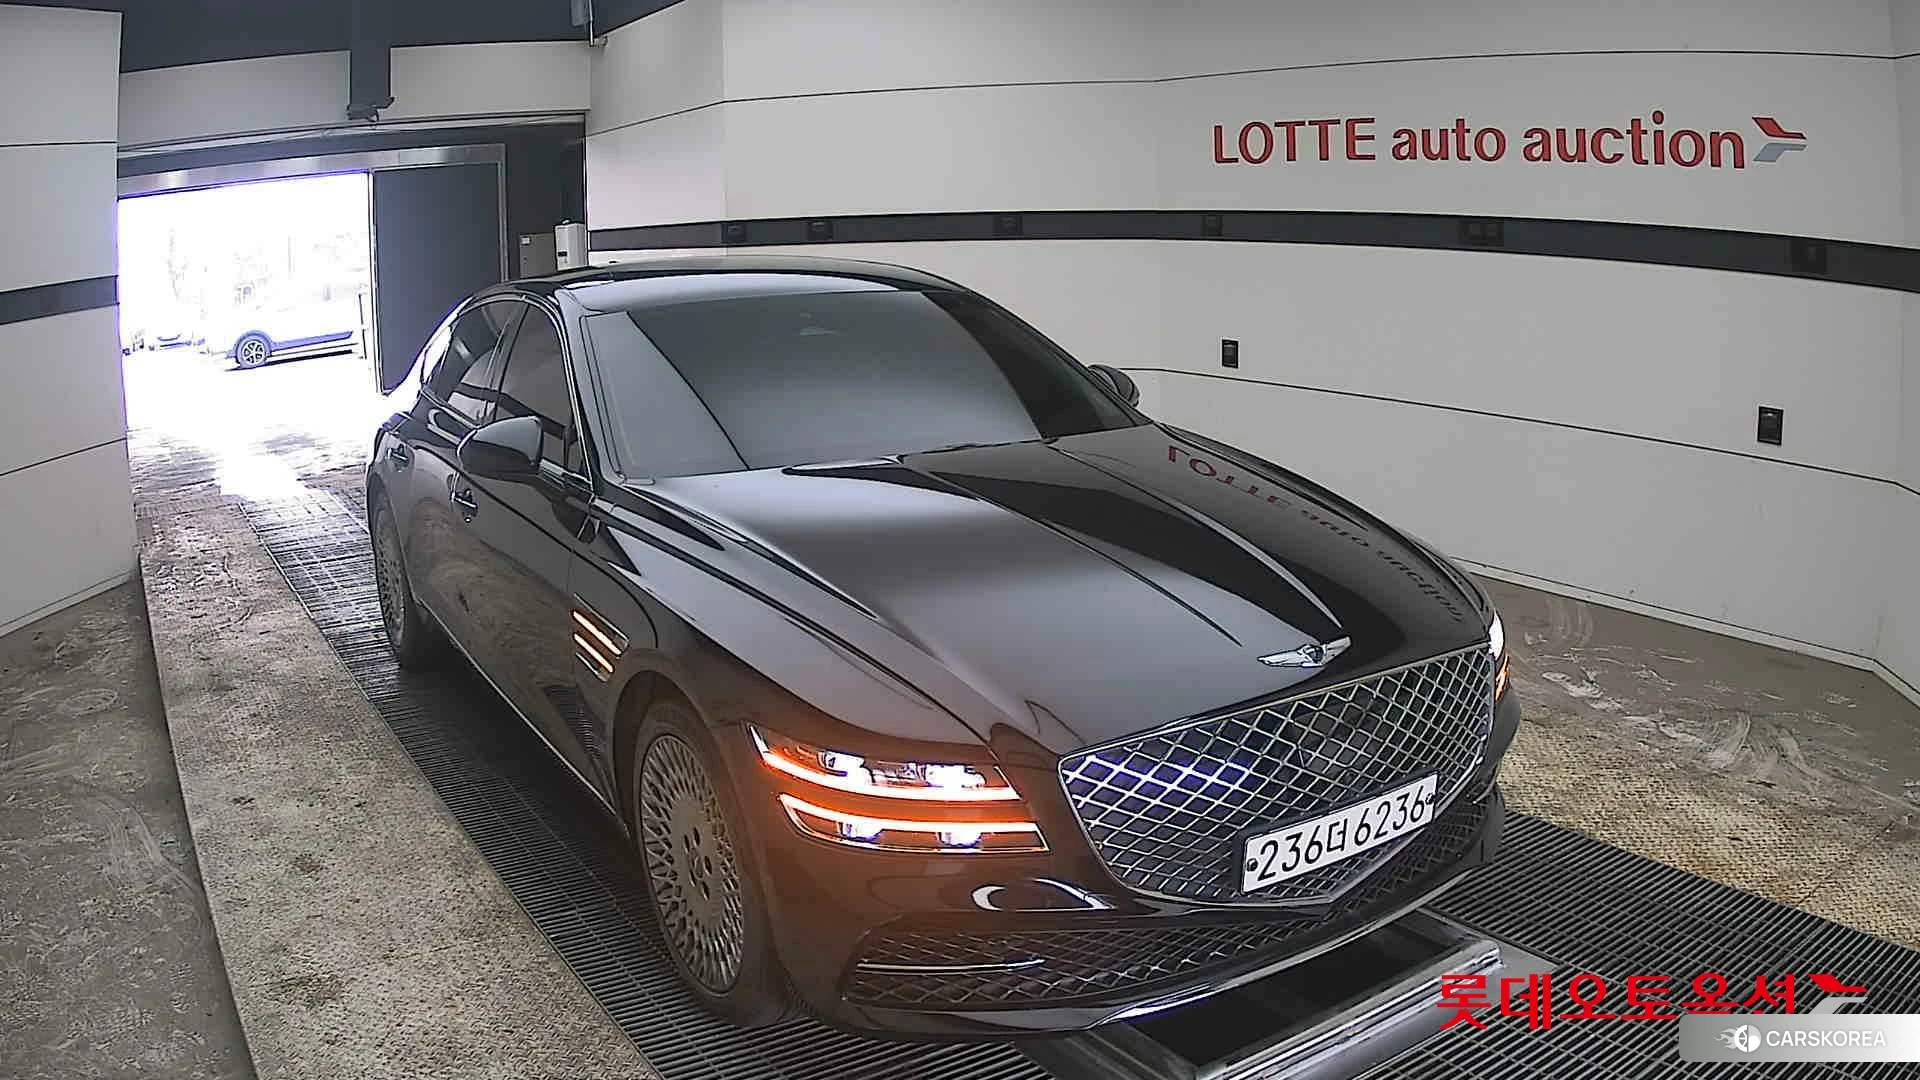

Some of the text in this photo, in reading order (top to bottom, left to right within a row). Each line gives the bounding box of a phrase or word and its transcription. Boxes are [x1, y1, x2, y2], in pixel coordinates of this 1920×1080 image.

[1213, 110, 1746, 169] LOTTE auto auction
